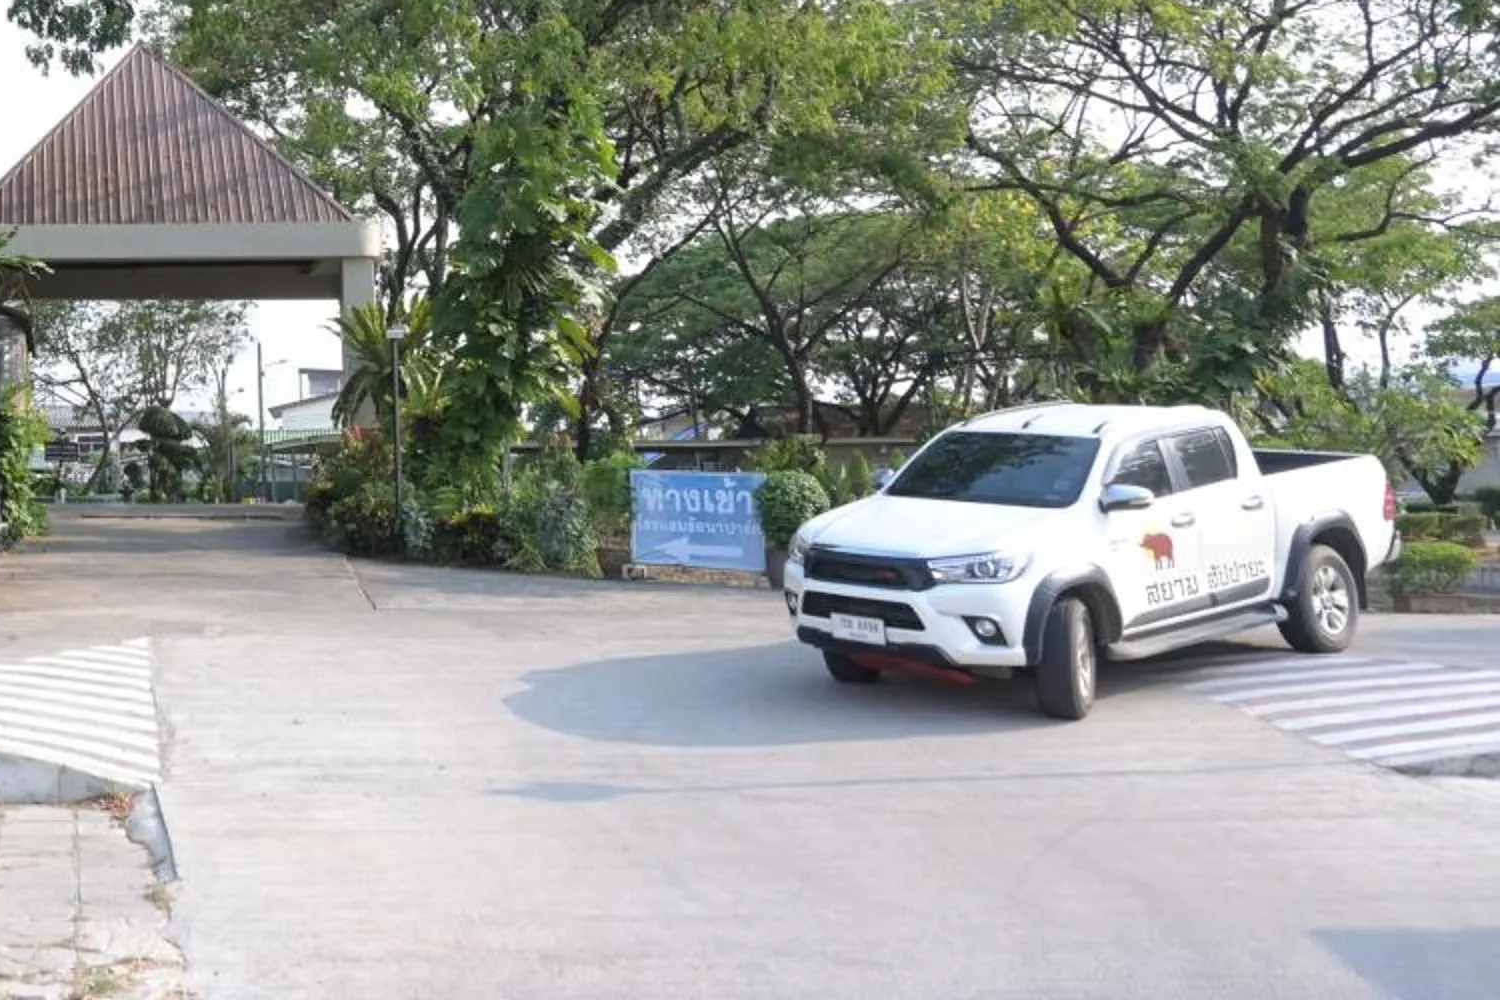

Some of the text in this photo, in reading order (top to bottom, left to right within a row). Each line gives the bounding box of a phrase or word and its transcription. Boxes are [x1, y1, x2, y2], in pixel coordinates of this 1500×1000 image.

[641, 477, 753, 515] ทางเข้า
[1145, 576, 1199, 606] สยาม
